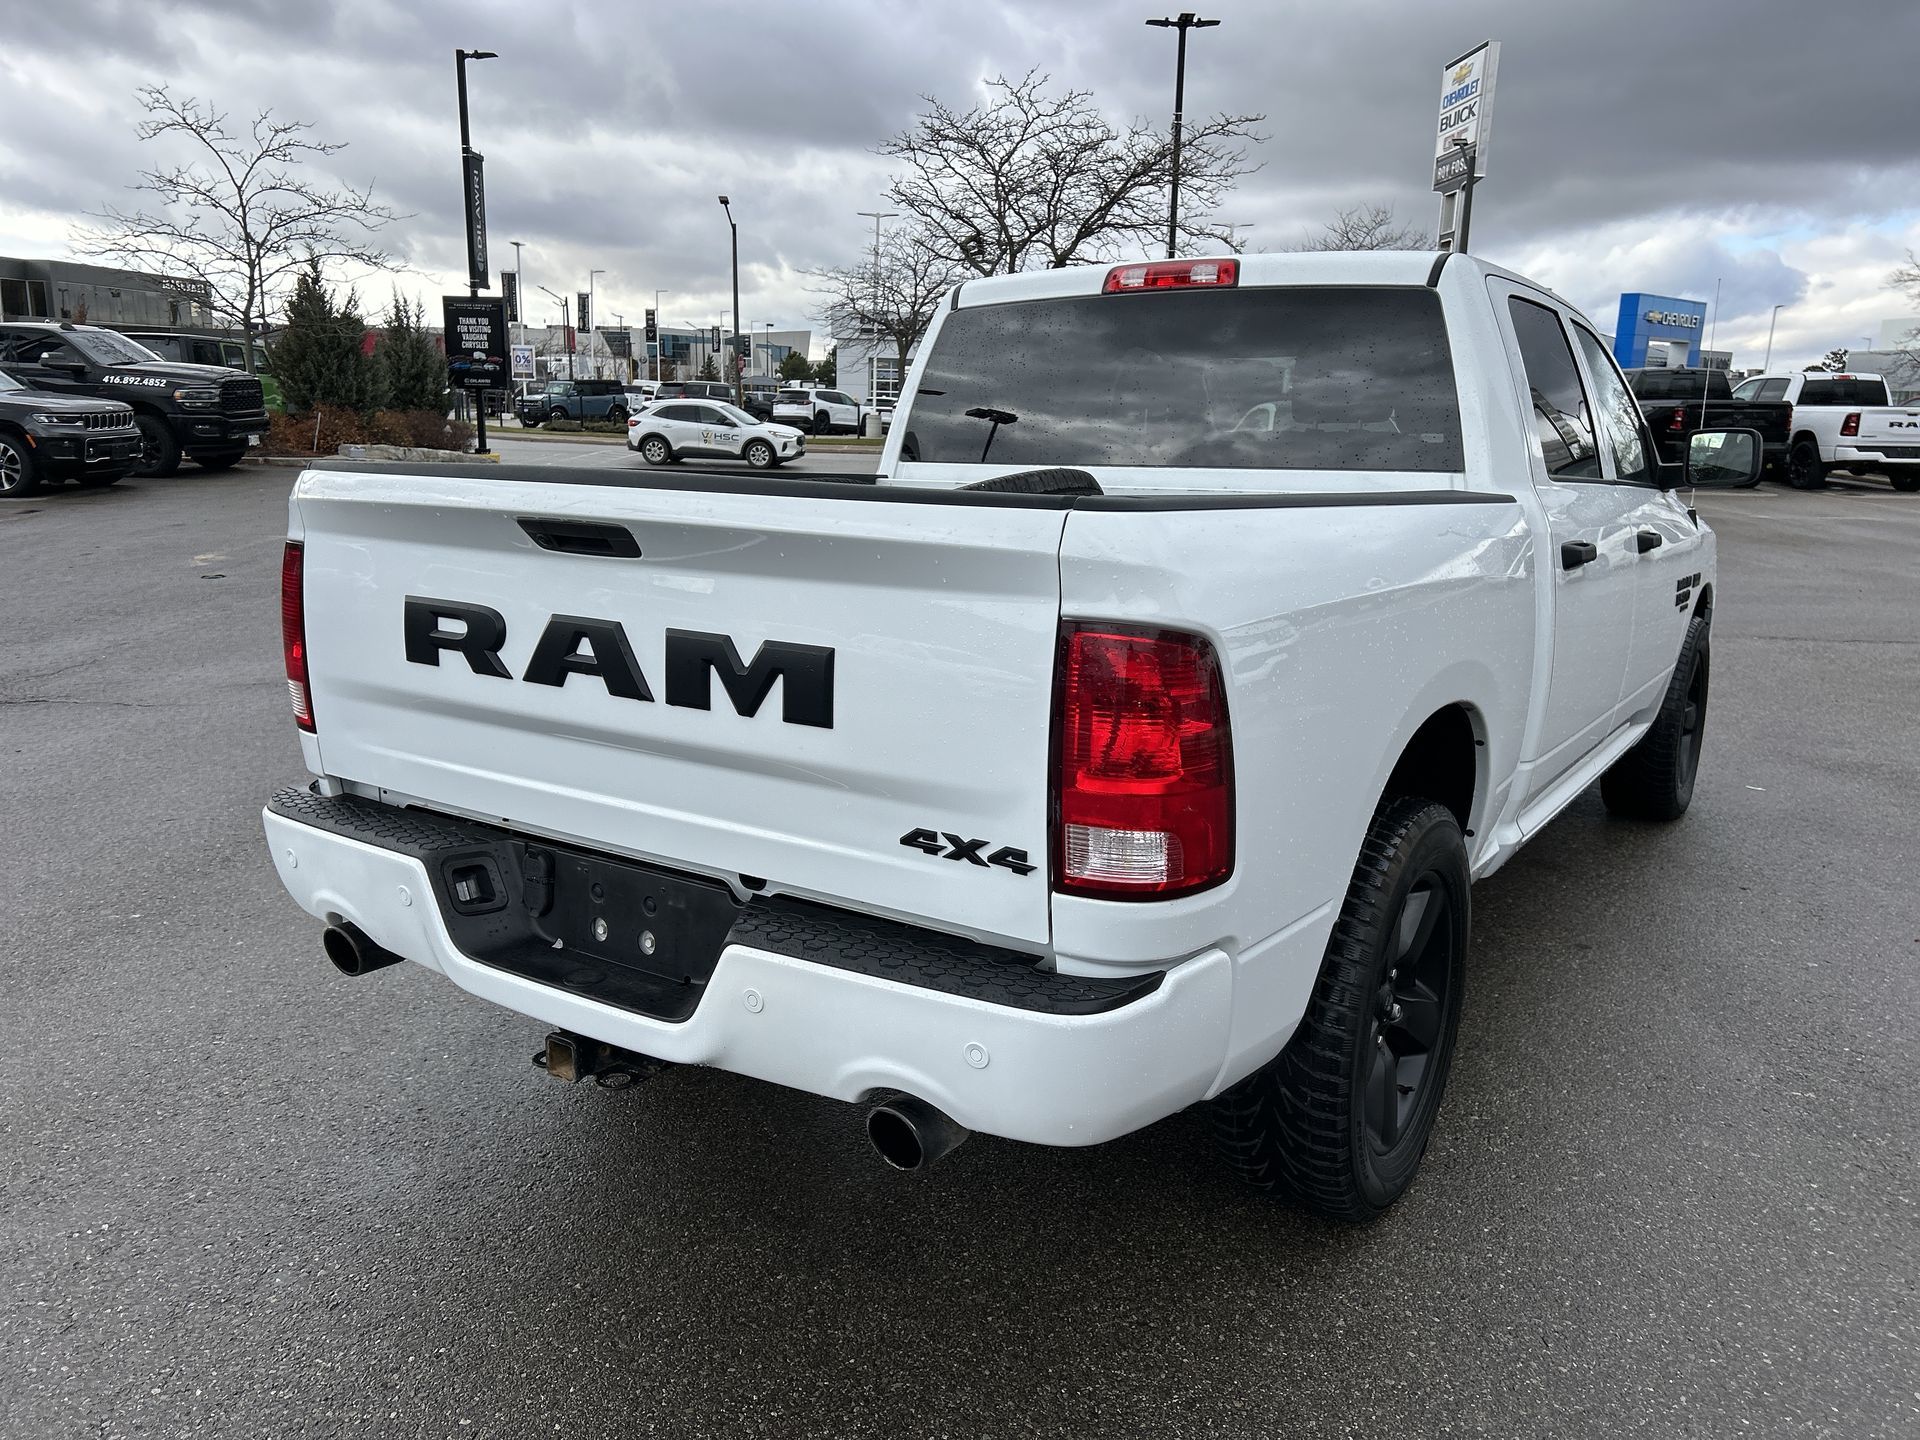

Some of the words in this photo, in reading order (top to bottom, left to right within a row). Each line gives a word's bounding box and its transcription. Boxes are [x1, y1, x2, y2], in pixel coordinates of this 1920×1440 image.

[1442, 78, 1480, 109] CHEVROLET
[1439, 101, 1477, 132] BUICK
[1438, 163, 1450, 179] ROY
[1451, 157, 1467, 174] FOS
[473, 169, 483, 249] DILAWRI
[458, 317, 477, 325] THANK
[478, 317, 489, 325] YOU
[1662, 311, 1700, 328] CHEVROLET
[457, 325, 468, 333] FOR
[469, 325, 491, 334] VISITING
[461, 333, 487, 341] VAUGHAN
[461, 341, 489, 349] CHRYSLER
[515, 354, 531, 364] 0%
[102, 375, 167, 388] 416.892.4852
[1889, 420, 1920, 429] RA
[713, 432, 740, 442] HSC
[404, 595, 835, 730] RAM
[900, 827, 1039, 877] 4X4
